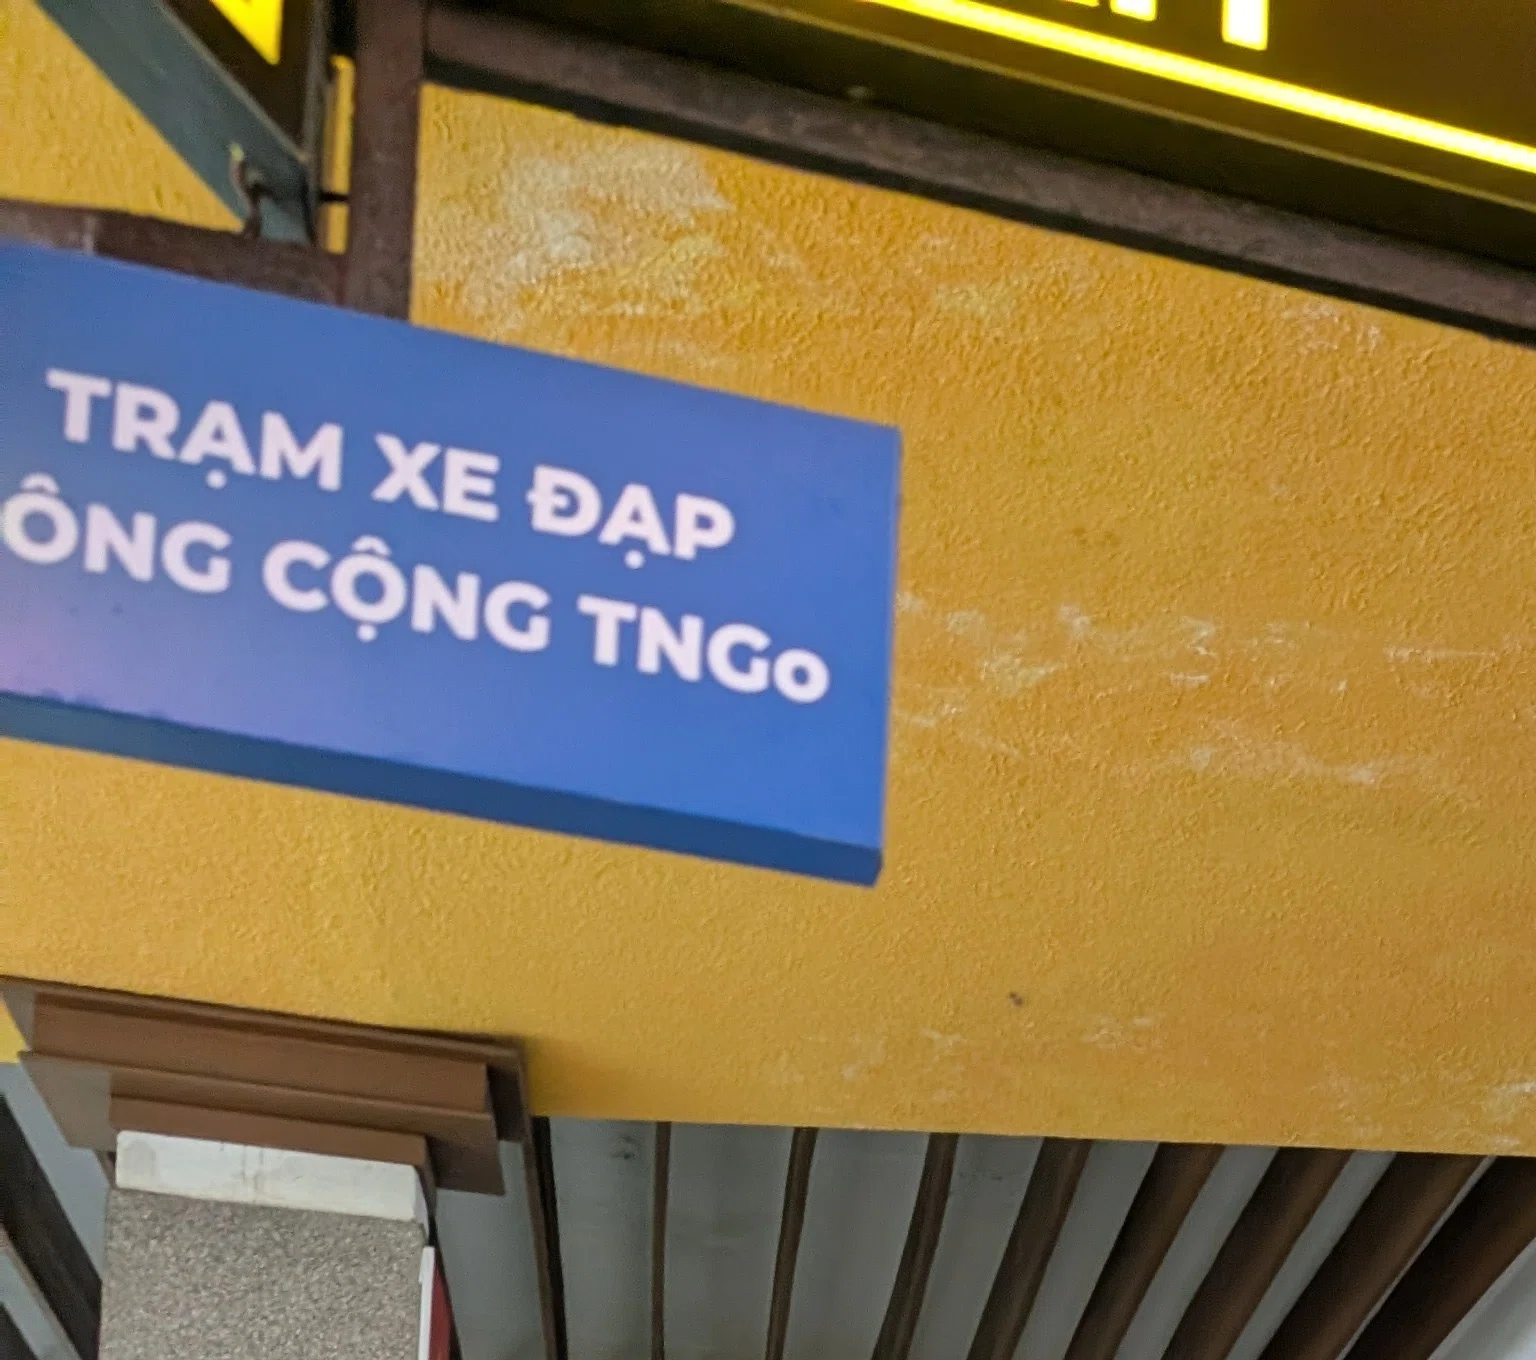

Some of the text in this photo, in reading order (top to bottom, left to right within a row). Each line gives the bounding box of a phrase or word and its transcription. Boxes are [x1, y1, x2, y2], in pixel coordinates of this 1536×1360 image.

[46, 368, 736, 570] TRẠM XE ĐẠP
[0, 472, 831, 704] ÔNG CỘNG TNGo
